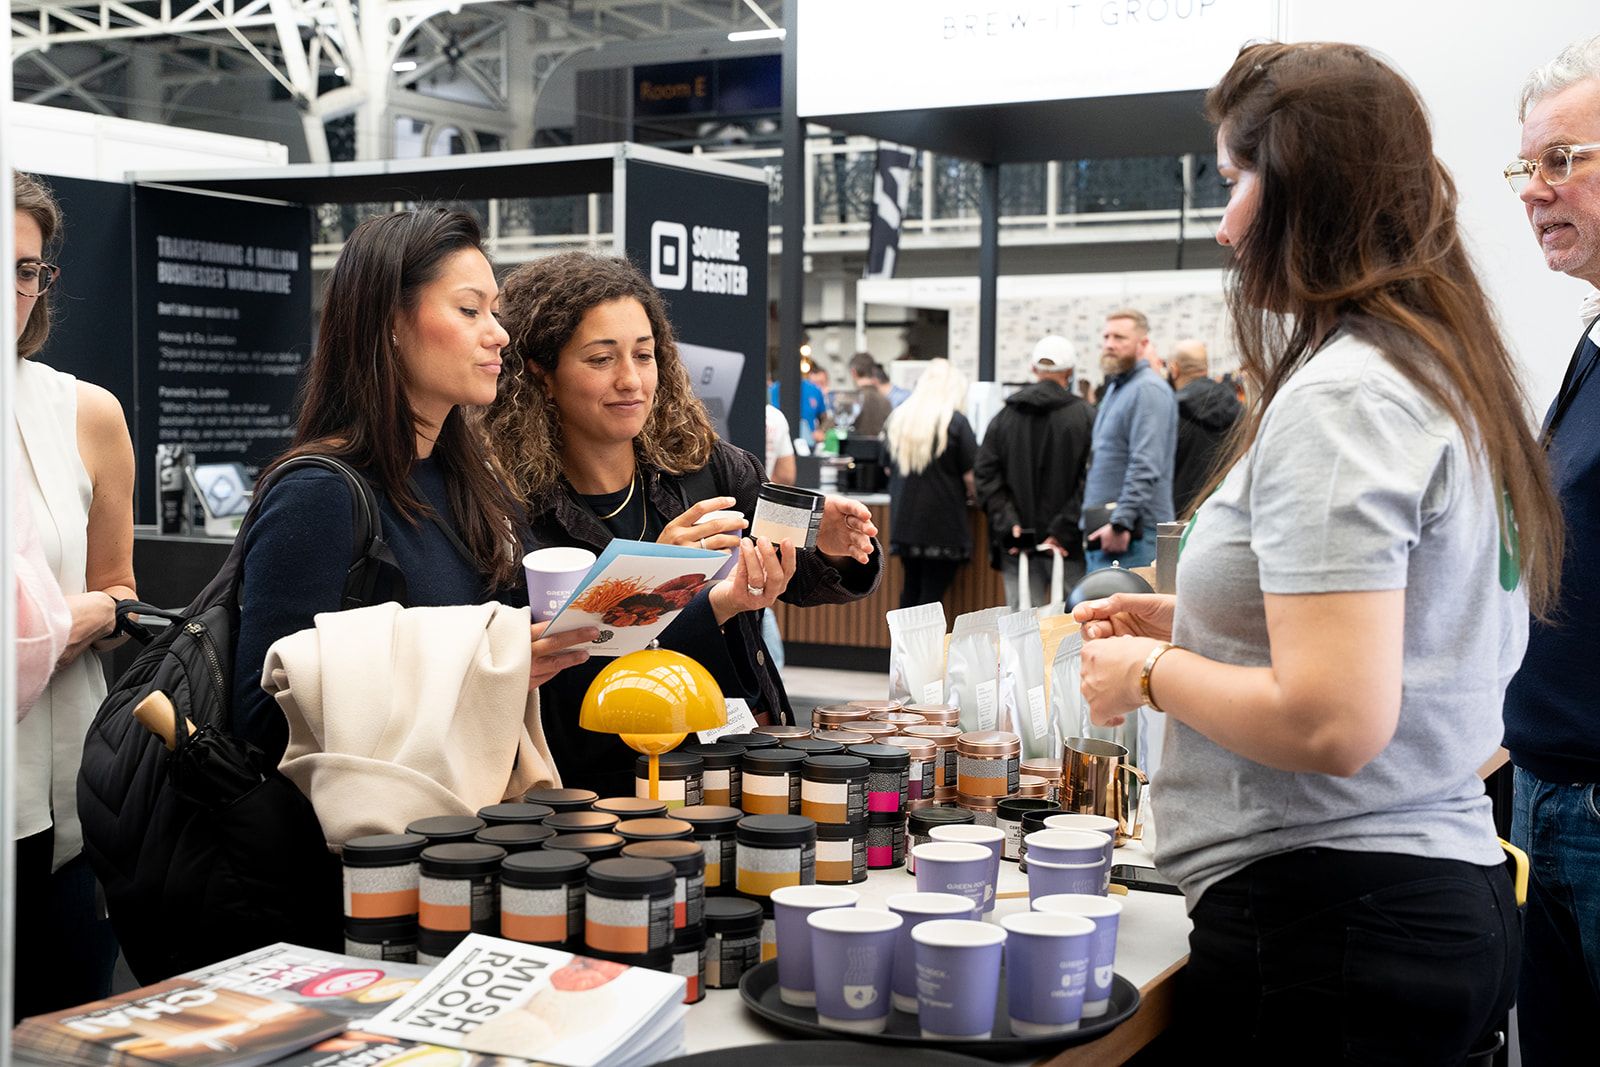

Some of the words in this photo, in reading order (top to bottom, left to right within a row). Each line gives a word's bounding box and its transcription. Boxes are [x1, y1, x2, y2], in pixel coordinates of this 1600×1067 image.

[943, 4, 1081, 40] BREW-IT
[1100, 0, 1216, 26] GROUP
[157, 235, 244, 266] TRANSFORMING
[255, 247, 299, 271] MILLION
[692, 225, 740, 262] SQUARE
[157, 261, 226, 289] BUSINESSES
[227, 268, 291, 295] WORLDWIDE
[692, 260, 748, 297] REGISTER
[407, 951, 516, 1030] ROOM
[439, 957, 549, 1035] MUSH
[65, 989, 218, 1034] CHAI
